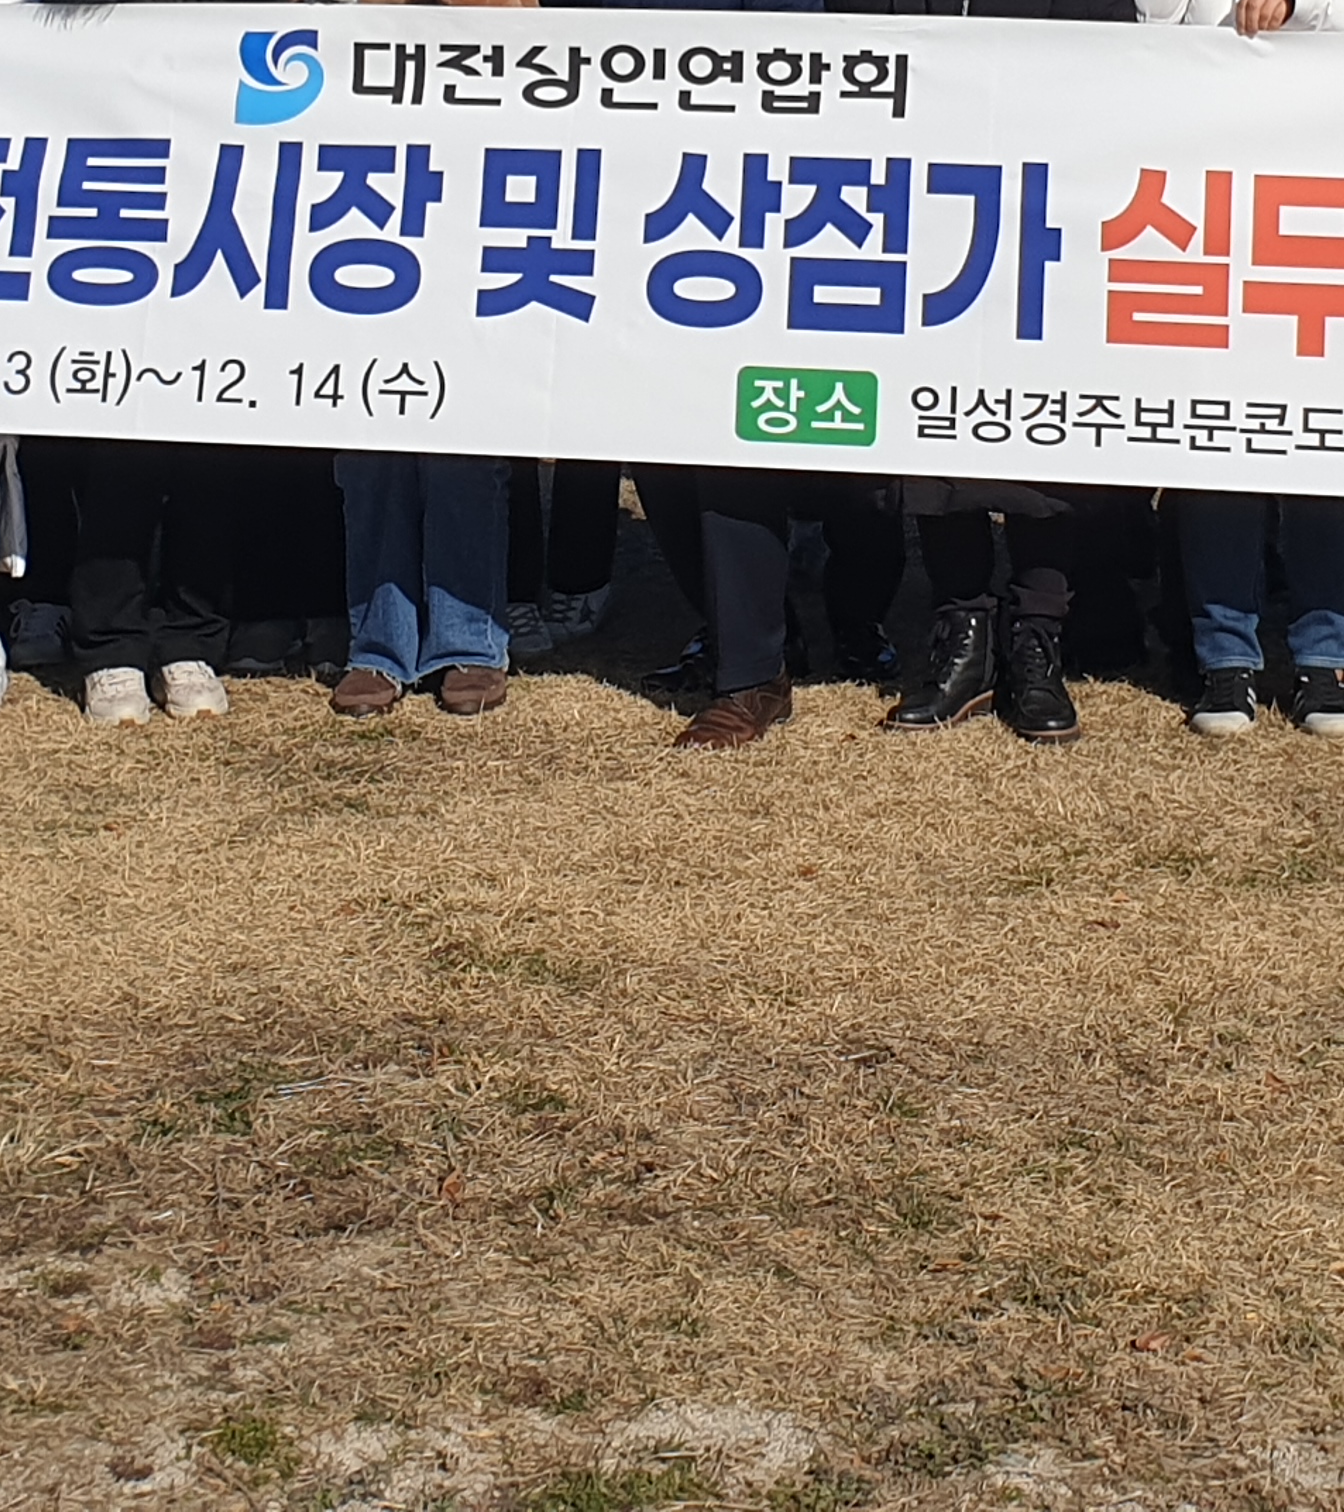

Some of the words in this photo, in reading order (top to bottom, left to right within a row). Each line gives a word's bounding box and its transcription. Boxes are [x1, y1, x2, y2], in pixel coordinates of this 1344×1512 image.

[353, 42, 909, 118] 대전상인연합회
[476, 148, 602, 324] 및
[644, 152, 1062, 341] 상점가
[750, 379, 864, 434] 장소
